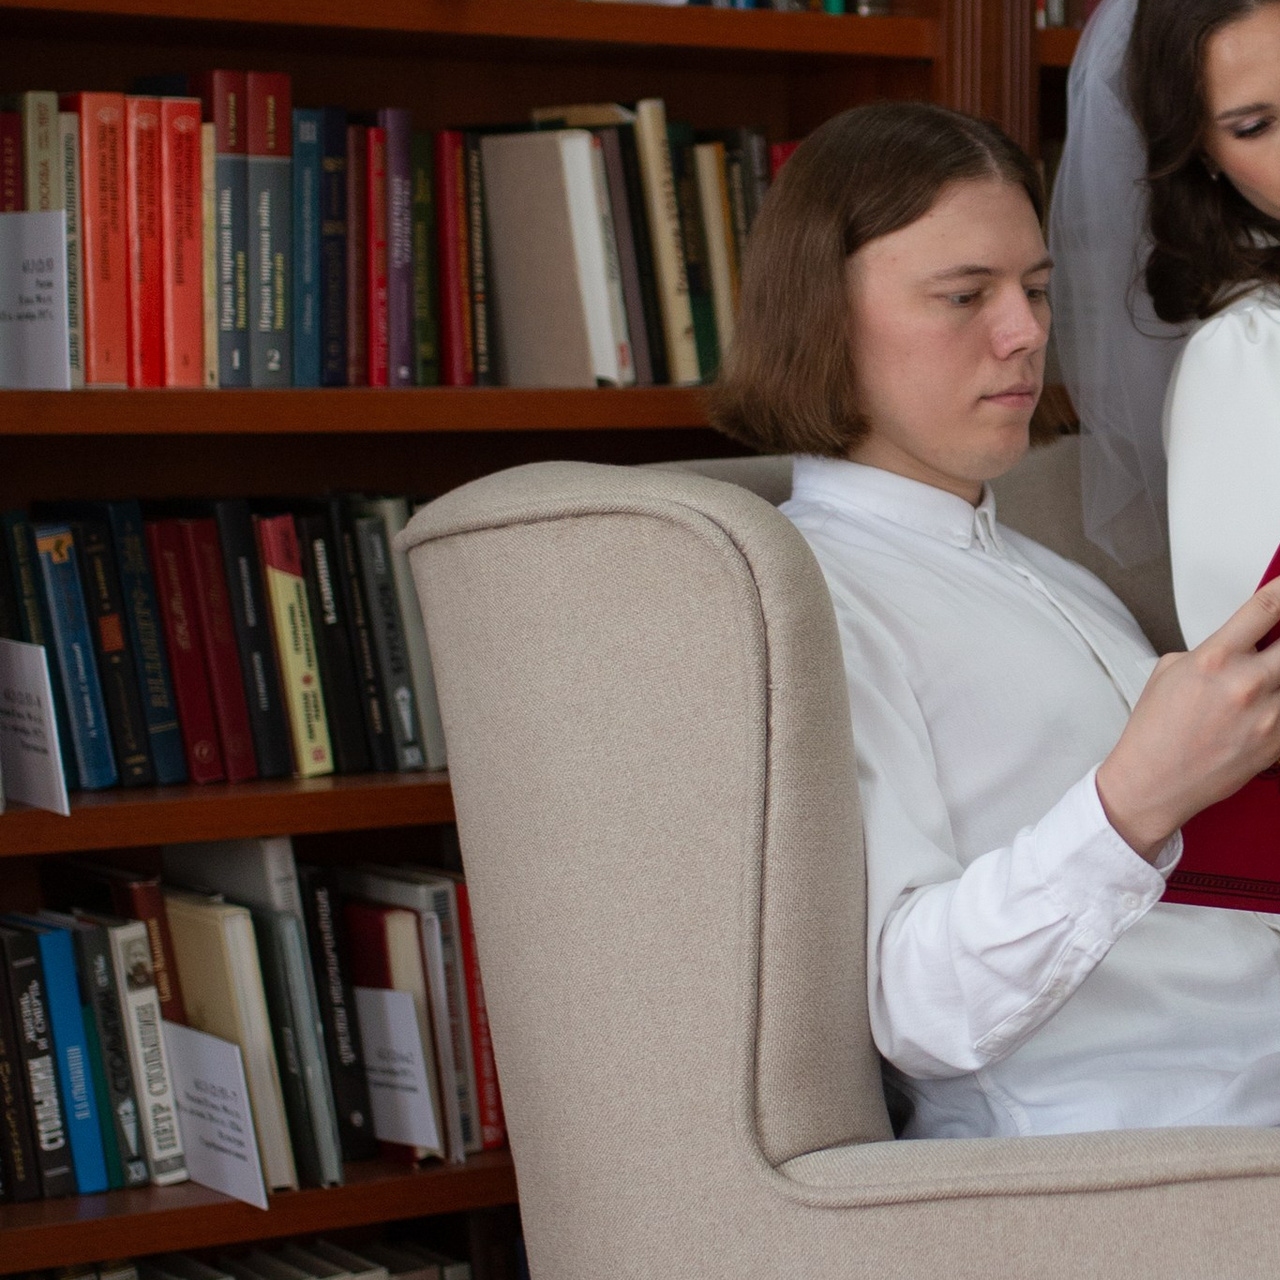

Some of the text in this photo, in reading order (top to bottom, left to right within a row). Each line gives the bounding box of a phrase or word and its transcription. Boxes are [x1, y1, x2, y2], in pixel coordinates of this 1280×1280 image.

[136, 1004, 167, 1096] СТОЛЫПИН
[27, 1055, 65, 1151] СТОЛЫПИН
[152, 1103, 176, 1150] ПЁТР
